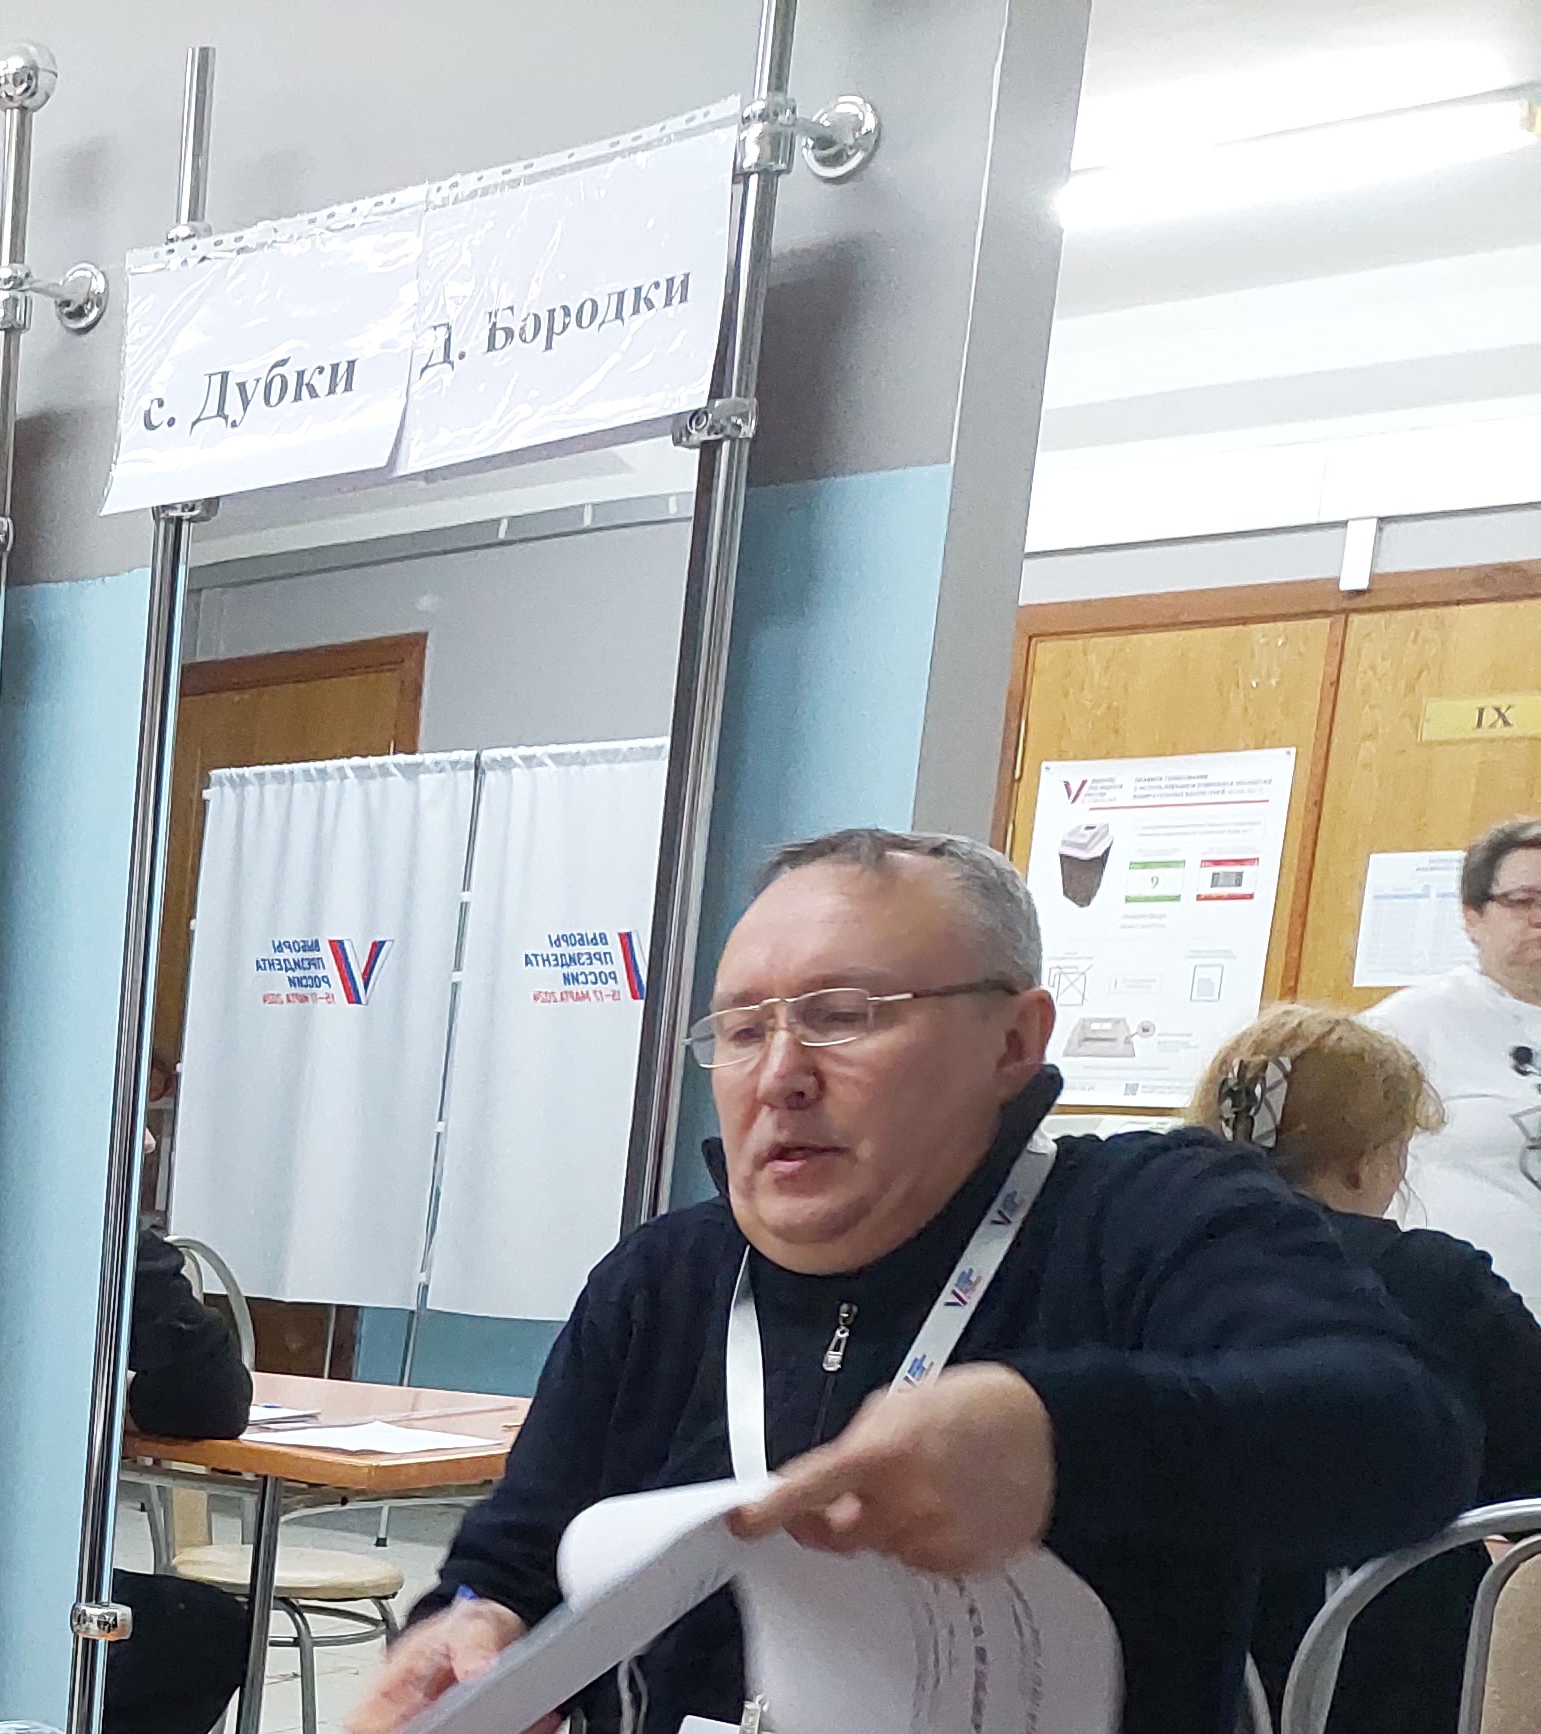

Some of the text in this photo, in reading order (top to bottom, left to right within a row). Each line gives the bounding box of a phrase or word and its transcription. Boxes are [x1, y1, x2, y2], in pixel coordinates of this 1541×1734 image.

[484, 271, 692, 354] Бородки
[143, 355, 359, 437] с. Дубки
[1472, 704, 1515, 731] IX
